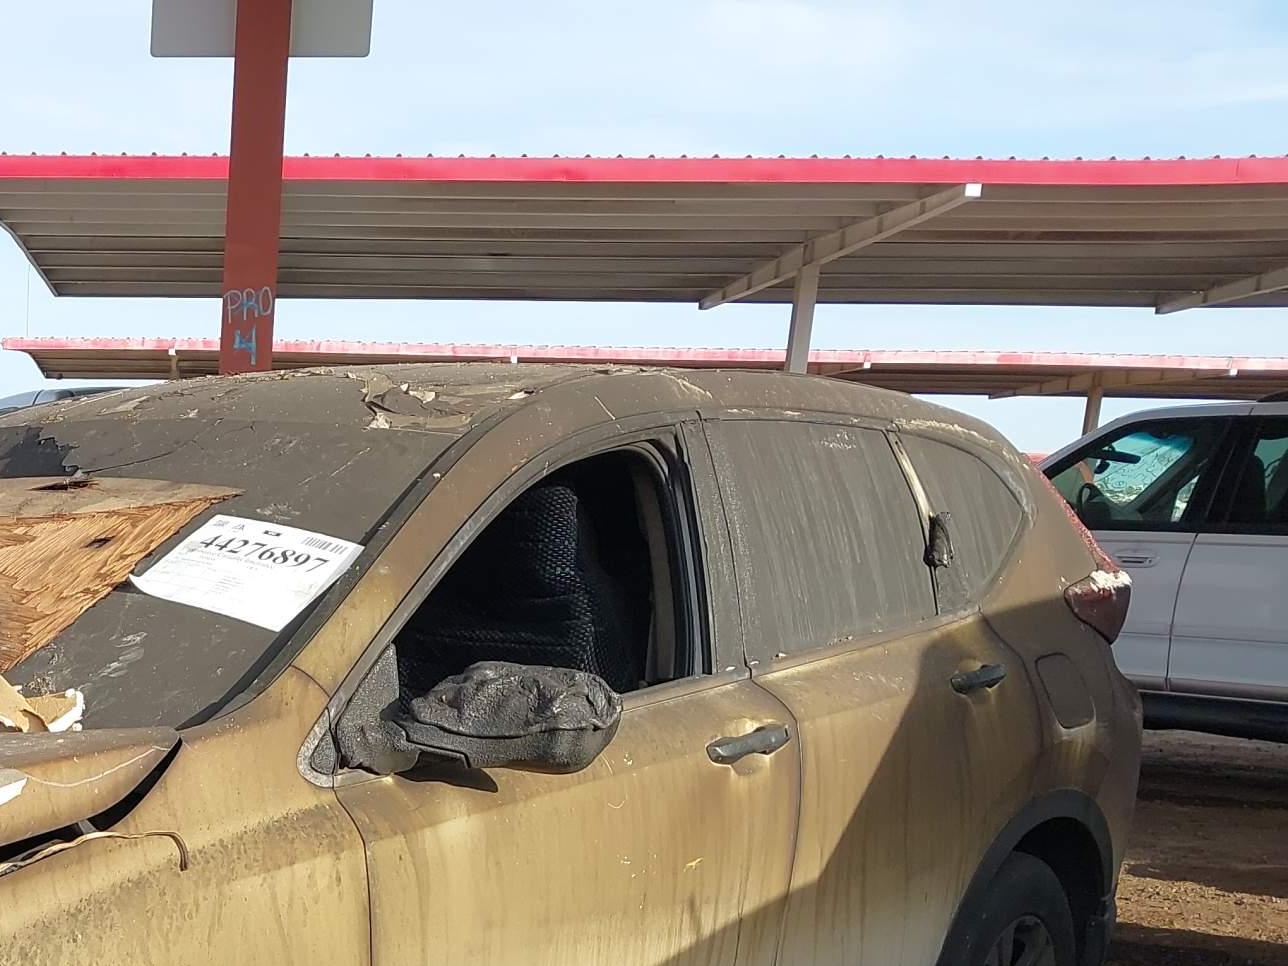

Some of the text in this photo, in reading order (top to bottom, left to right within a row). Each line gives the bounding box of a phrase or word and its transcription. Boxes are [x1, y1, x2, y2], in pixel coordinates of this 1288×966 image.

[223, 286, 273, 324] PRO
[233, 326, 257, 366] 4
[200, 534, 330, 573] 44276897
